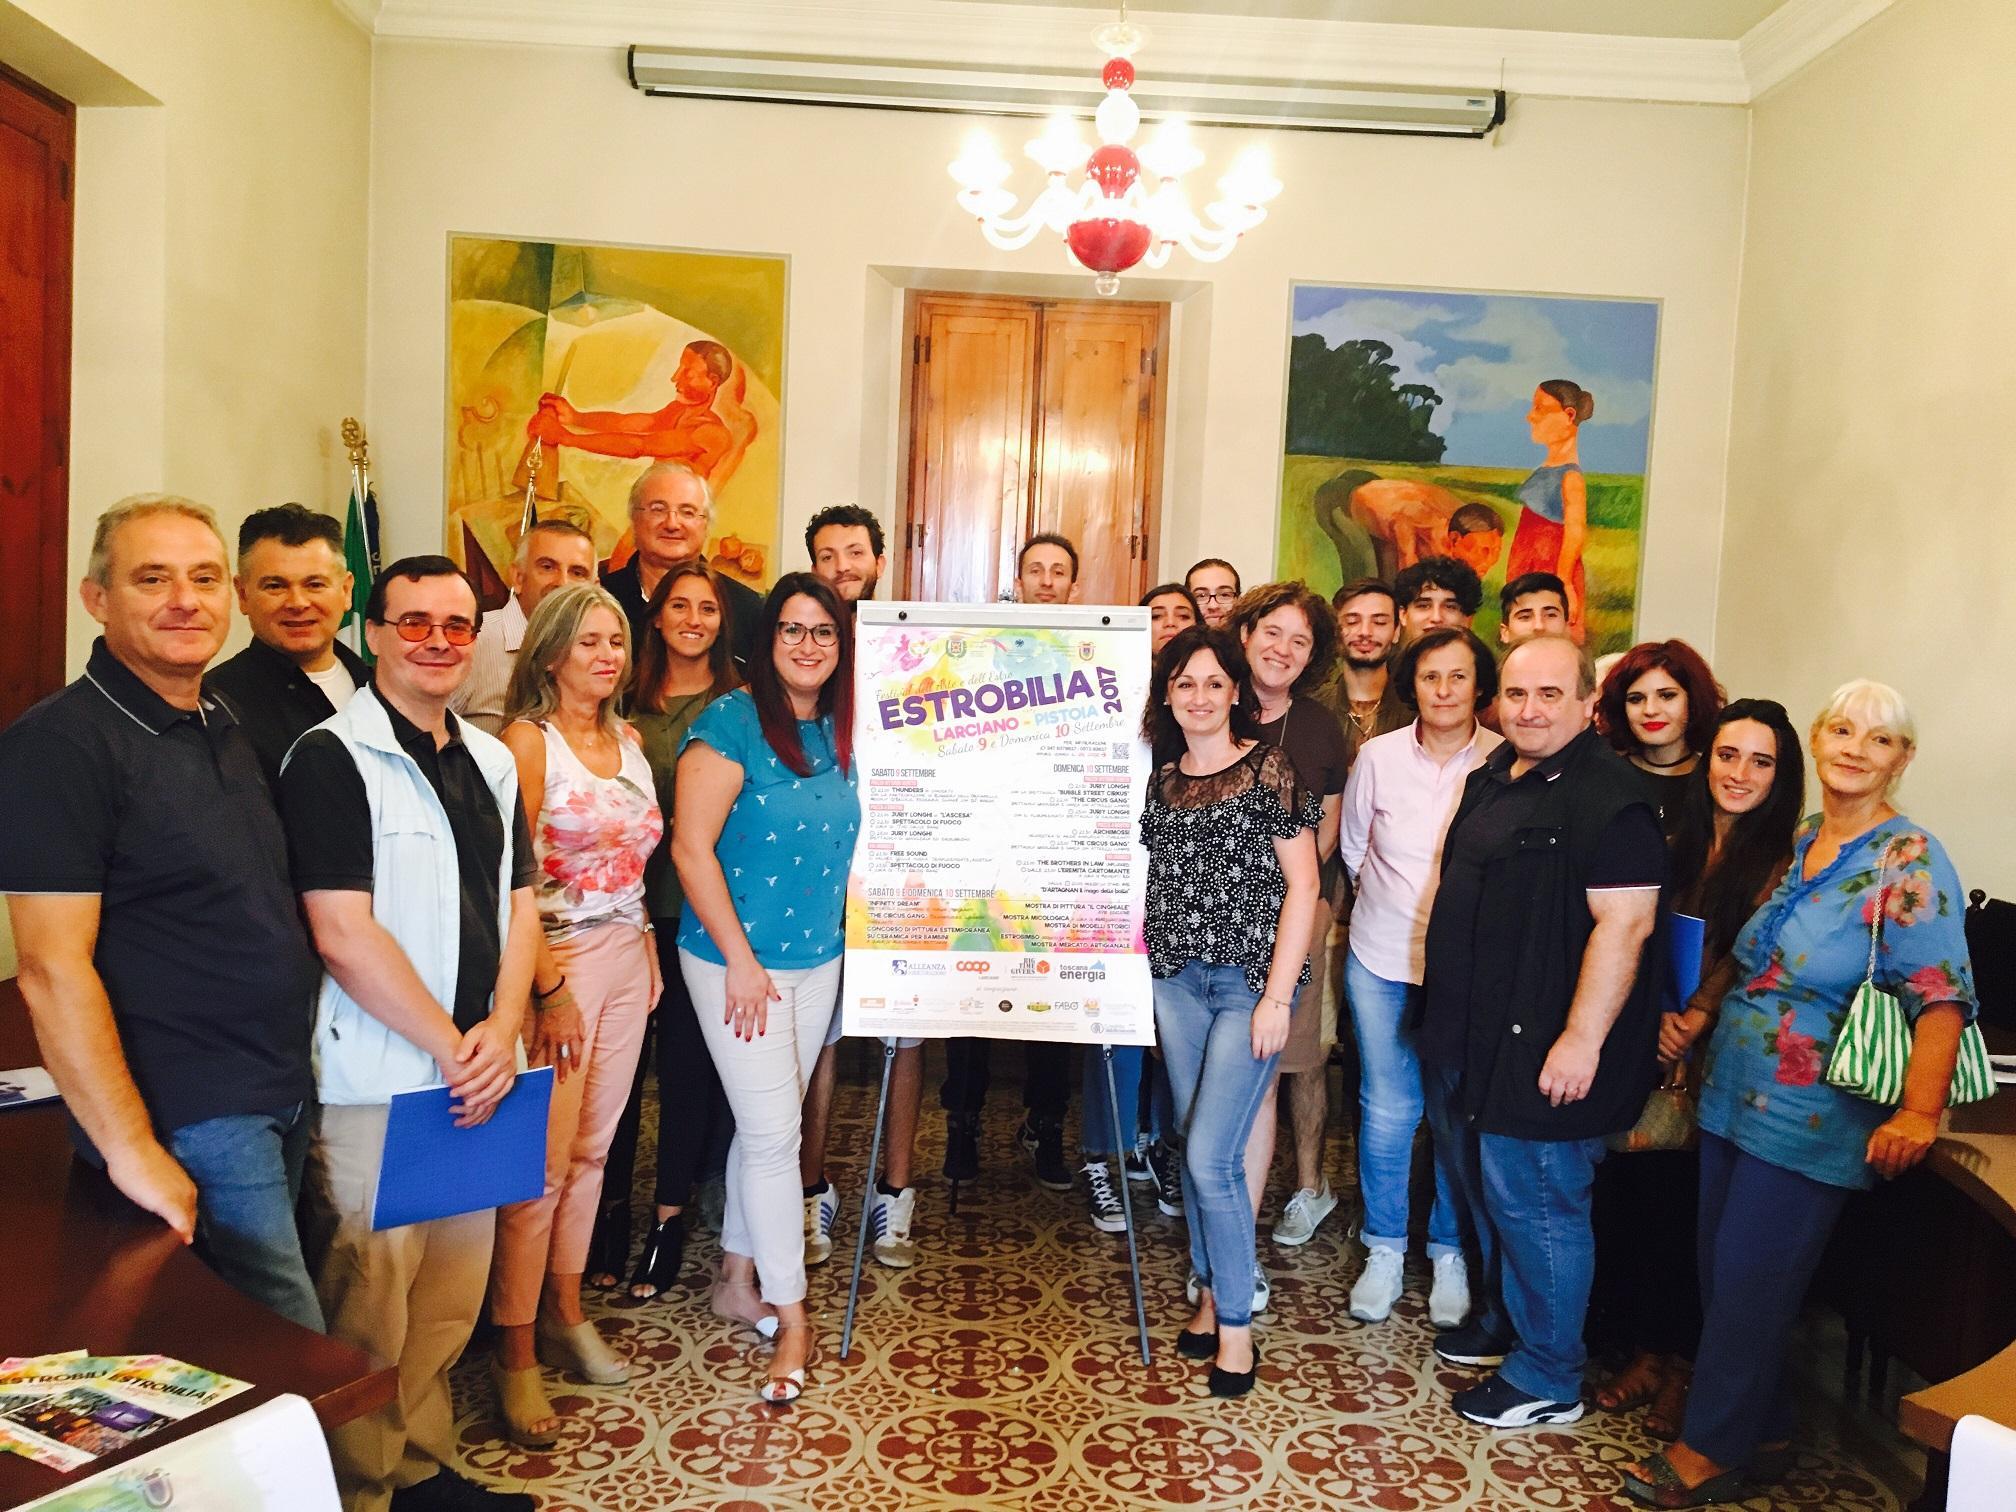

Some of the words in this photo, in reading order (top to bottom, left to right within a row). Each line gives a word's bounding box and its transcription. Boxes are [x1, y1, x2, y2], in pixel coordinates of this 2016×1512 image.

[1096, 666, 1123, 714] 2017
[878, 670, 1094, 730] ESTROBILIA
[934, 717, 1019, 742] LARCIANO
[1035, 705, 1098, 726] PISTOIA
[938, 743, 973, 758] Sabato
[978, 738, 987, 751] 9
[1000, 731, 1050, 747] Domenica
[1055, 724, 1070, 738] 10
[1074, 716, 1125, 735] Settembre
[872, 768, 895, 777] SABATO
[901, 769, 936, 778] SETTEMBRE
[1053, 764, 1084, 773] DOMENICA
[1086, 764, 1094, 773] 10
[1094, 765, 1130, 774] SETTEMBRE
[868, 888, 894, 897] SABATO
[908, 888, 943, 898] DOMENICA
[946, 889, 954, 898] 10
[955, 889, 995, 899] SETTEMBRE
[956, 960, 990, 974] coop
[1060, 971, 1106, 982] energia
